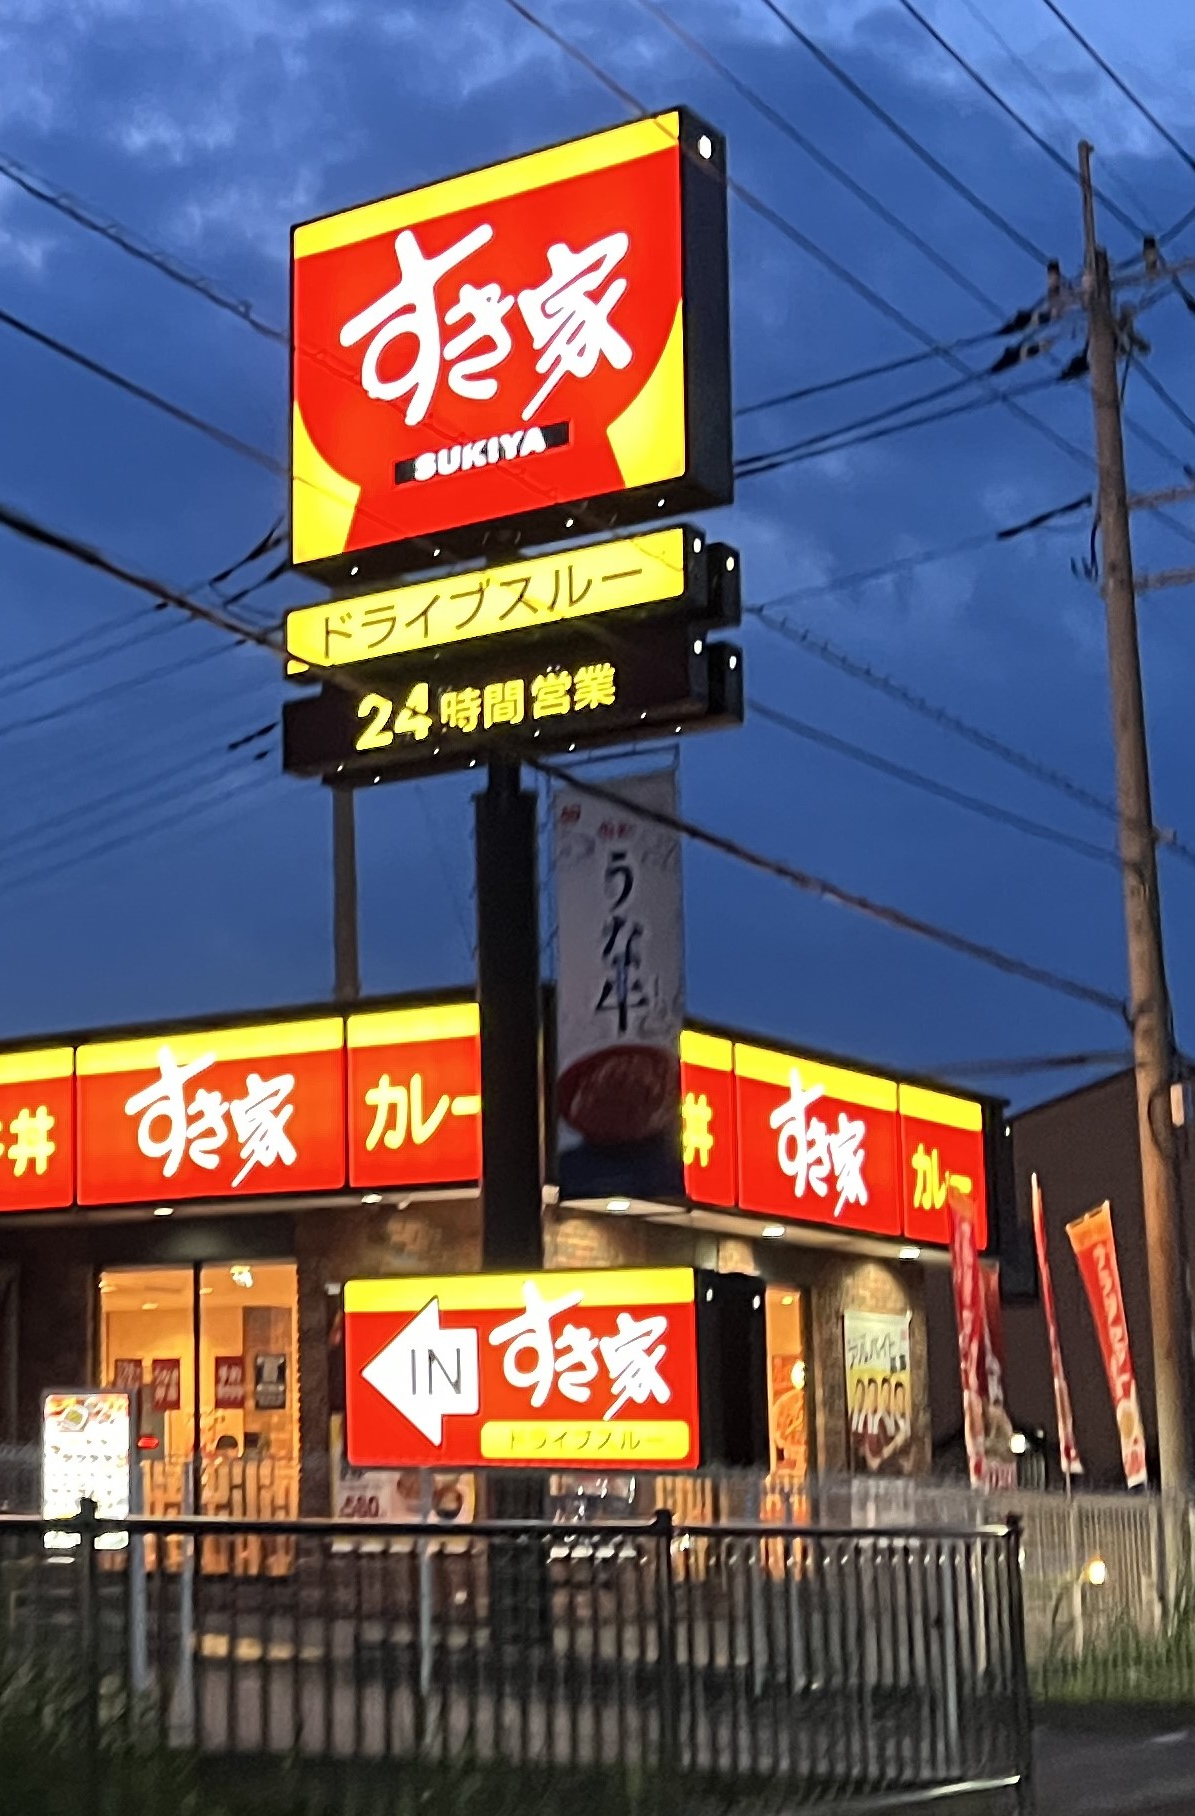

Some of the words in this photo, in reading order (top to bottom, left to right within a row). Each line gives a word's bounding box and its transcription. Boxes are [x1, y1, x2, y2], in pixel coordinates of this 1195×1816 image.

[338, 222, 634, 426] すき家
[412, 425, 548, 483] SUKIYA
[320, 561, 644, 660] ドライブスルー
[355, 662, 617, 752] 24時間営業
[124, 1045, 297, 1188] すき家
[364, 1072, 482, 1151] カレー
[769, 1067, 869, 1218] すき家
[409, 1346, 462, 1396] IN
[488, 1281, 671, 1421] すき家
